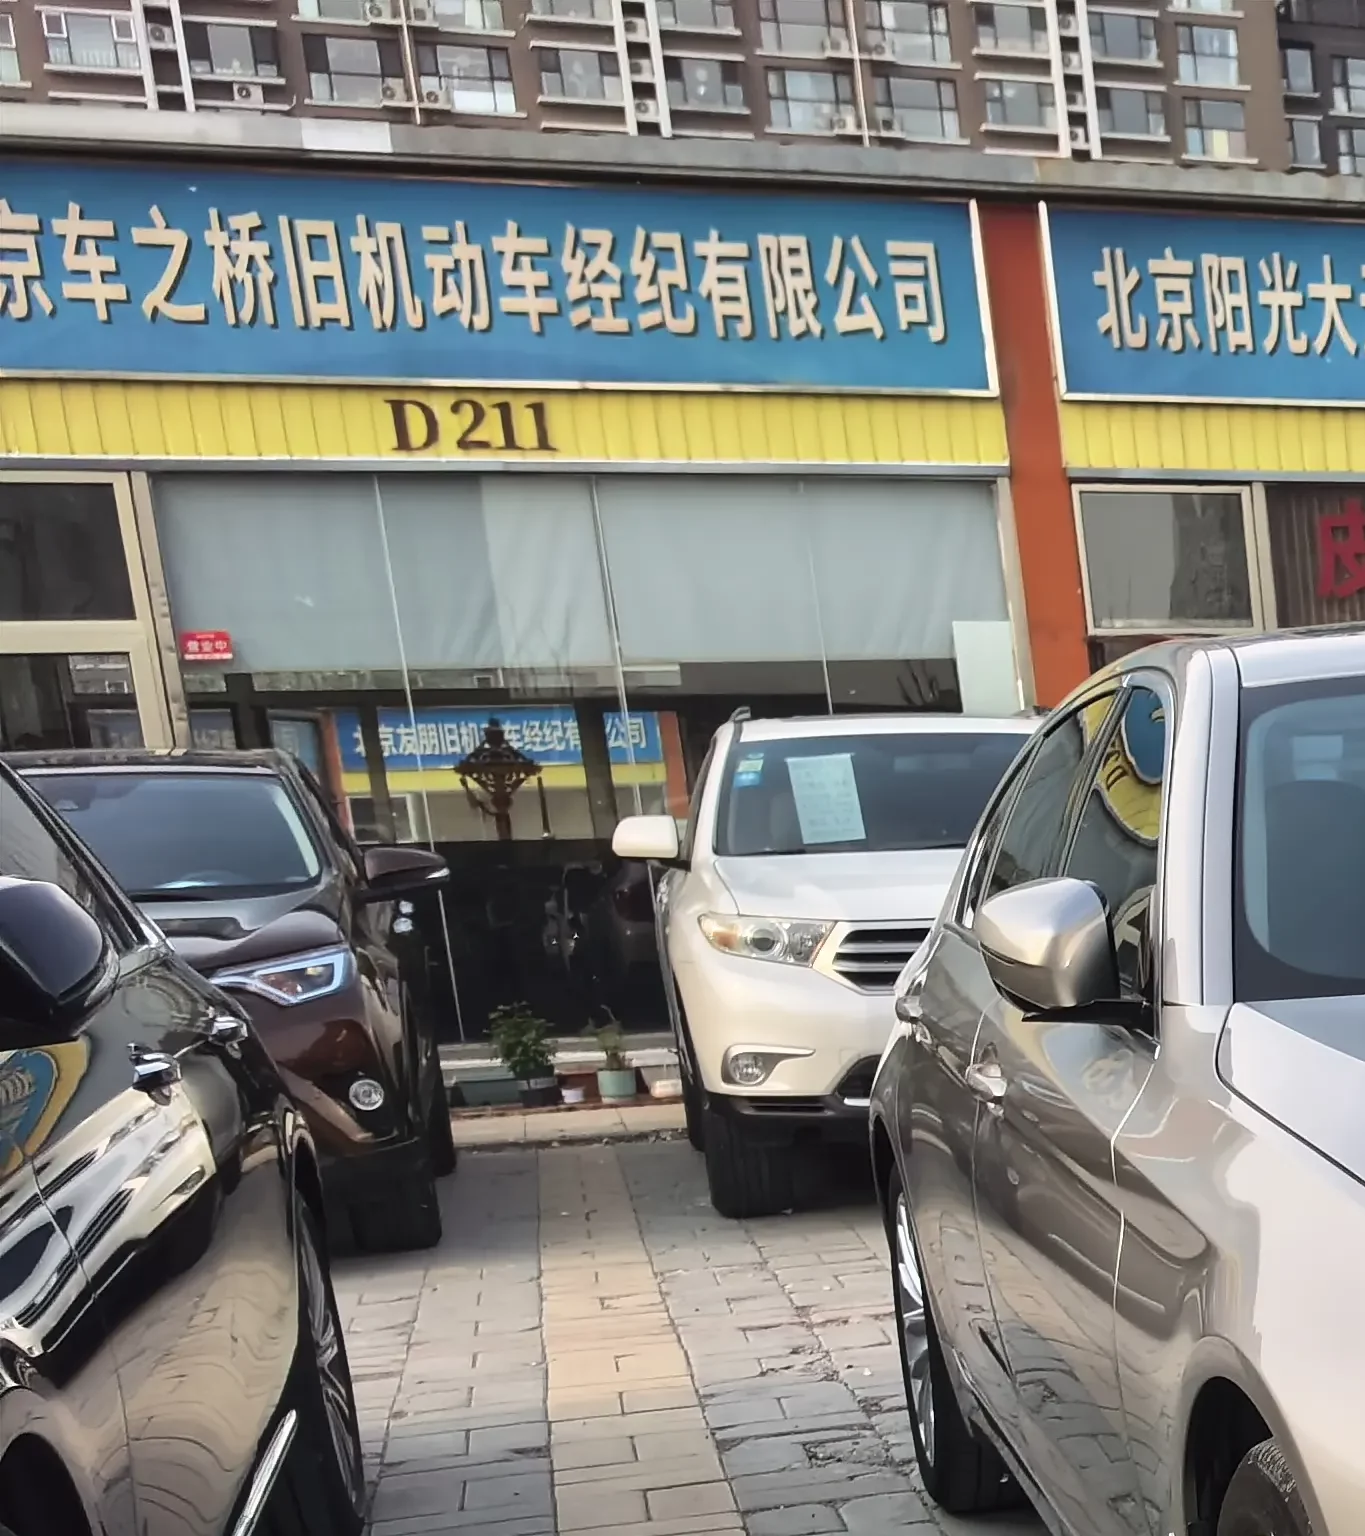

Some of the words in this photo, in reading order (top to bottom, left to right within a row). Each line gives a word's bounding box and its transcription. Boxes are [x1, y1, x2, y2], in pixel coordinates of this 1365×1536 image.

[0, 197, 948, 344] 京车之桥旧机动车经纪有限公司
[385, 398, 558, 452] D211
